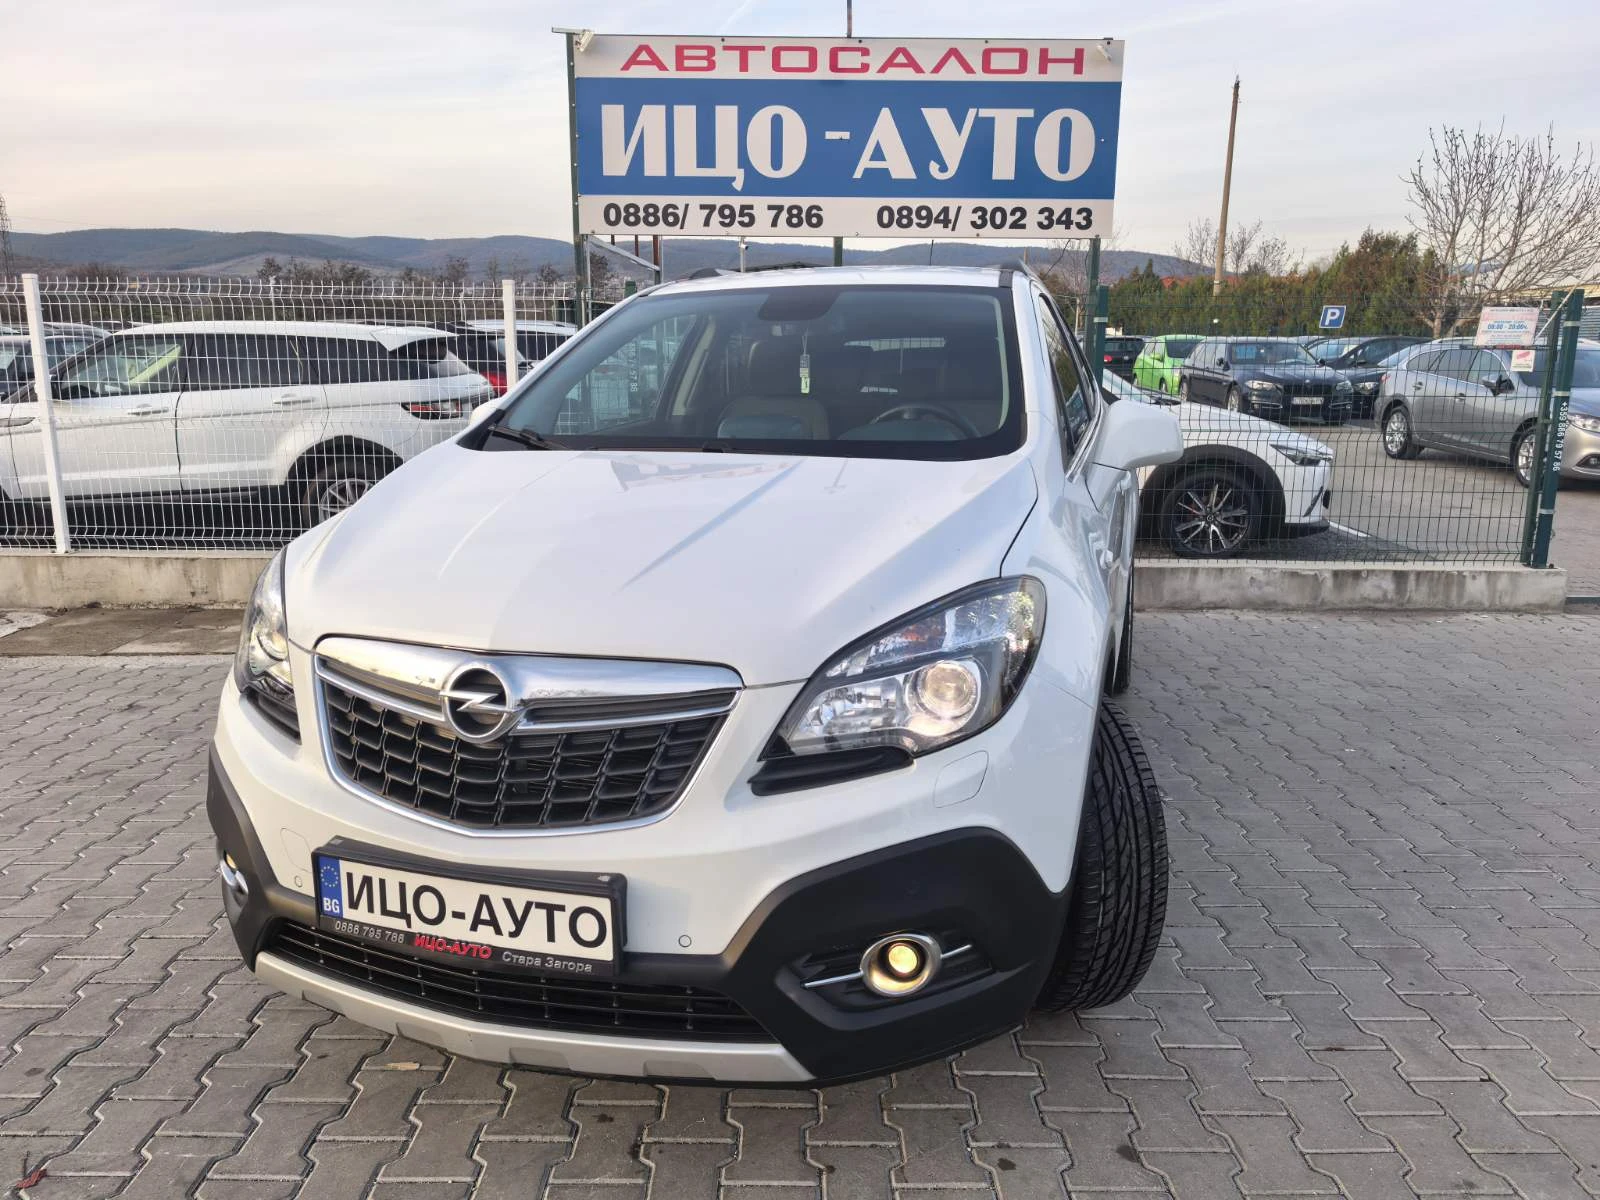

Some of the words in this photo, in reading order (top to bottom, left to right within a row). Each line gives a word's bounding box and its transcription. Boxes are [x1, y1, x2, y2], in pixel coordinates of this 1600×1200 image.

[620, 44, 1084, 75] АВТОСАЛОН
[603, 202, 690, 230] 0886/
[699, 203, 756, 228] 795
[767, 204, 824, 229] 786
[876, 205, 962, 231] 0894/
[970, 205, 1027, 230] 302
[1036, 206, 1093, 231] 343
[1324, 308, 1341, 326] P
[323, 897, 340, 914] BG
[346, 871, 607, 949] ИЦО-АУТО
[362, 926, 382, 939] 795
[414, 933, 492, 959] ИЦО-АУТО
[502, 951, 542, 967] Стара
[545, 956, 593, 973] Загора
